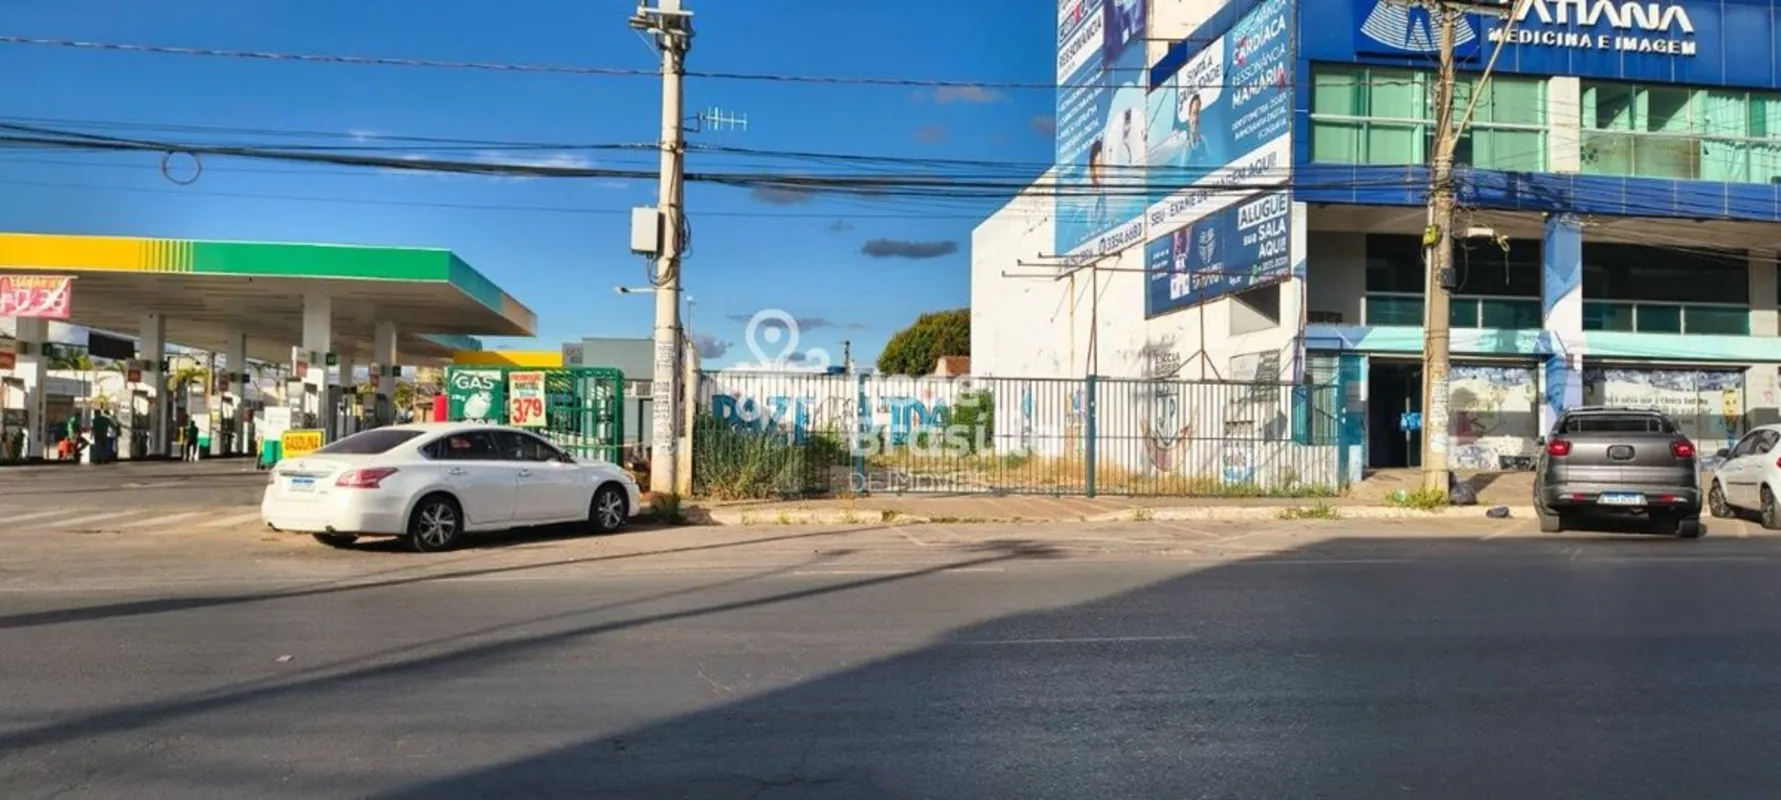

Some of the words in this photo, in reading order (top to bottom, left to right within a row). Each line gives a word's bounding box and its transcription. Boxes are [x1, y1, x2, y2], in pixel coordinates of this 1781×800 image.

[1499, 0, 1695, 34] ATIANA
[1488, 28, 1592, 48] MEDICINA
[1598, 35, 1610, 49] E
[1615, 37, 1696, 55] IMAGEM
[1241, 193, 1286, 226] ALUGUE
[1258, 217, 1286, 241] SALA
[456, 376, 494, 389] GAS
